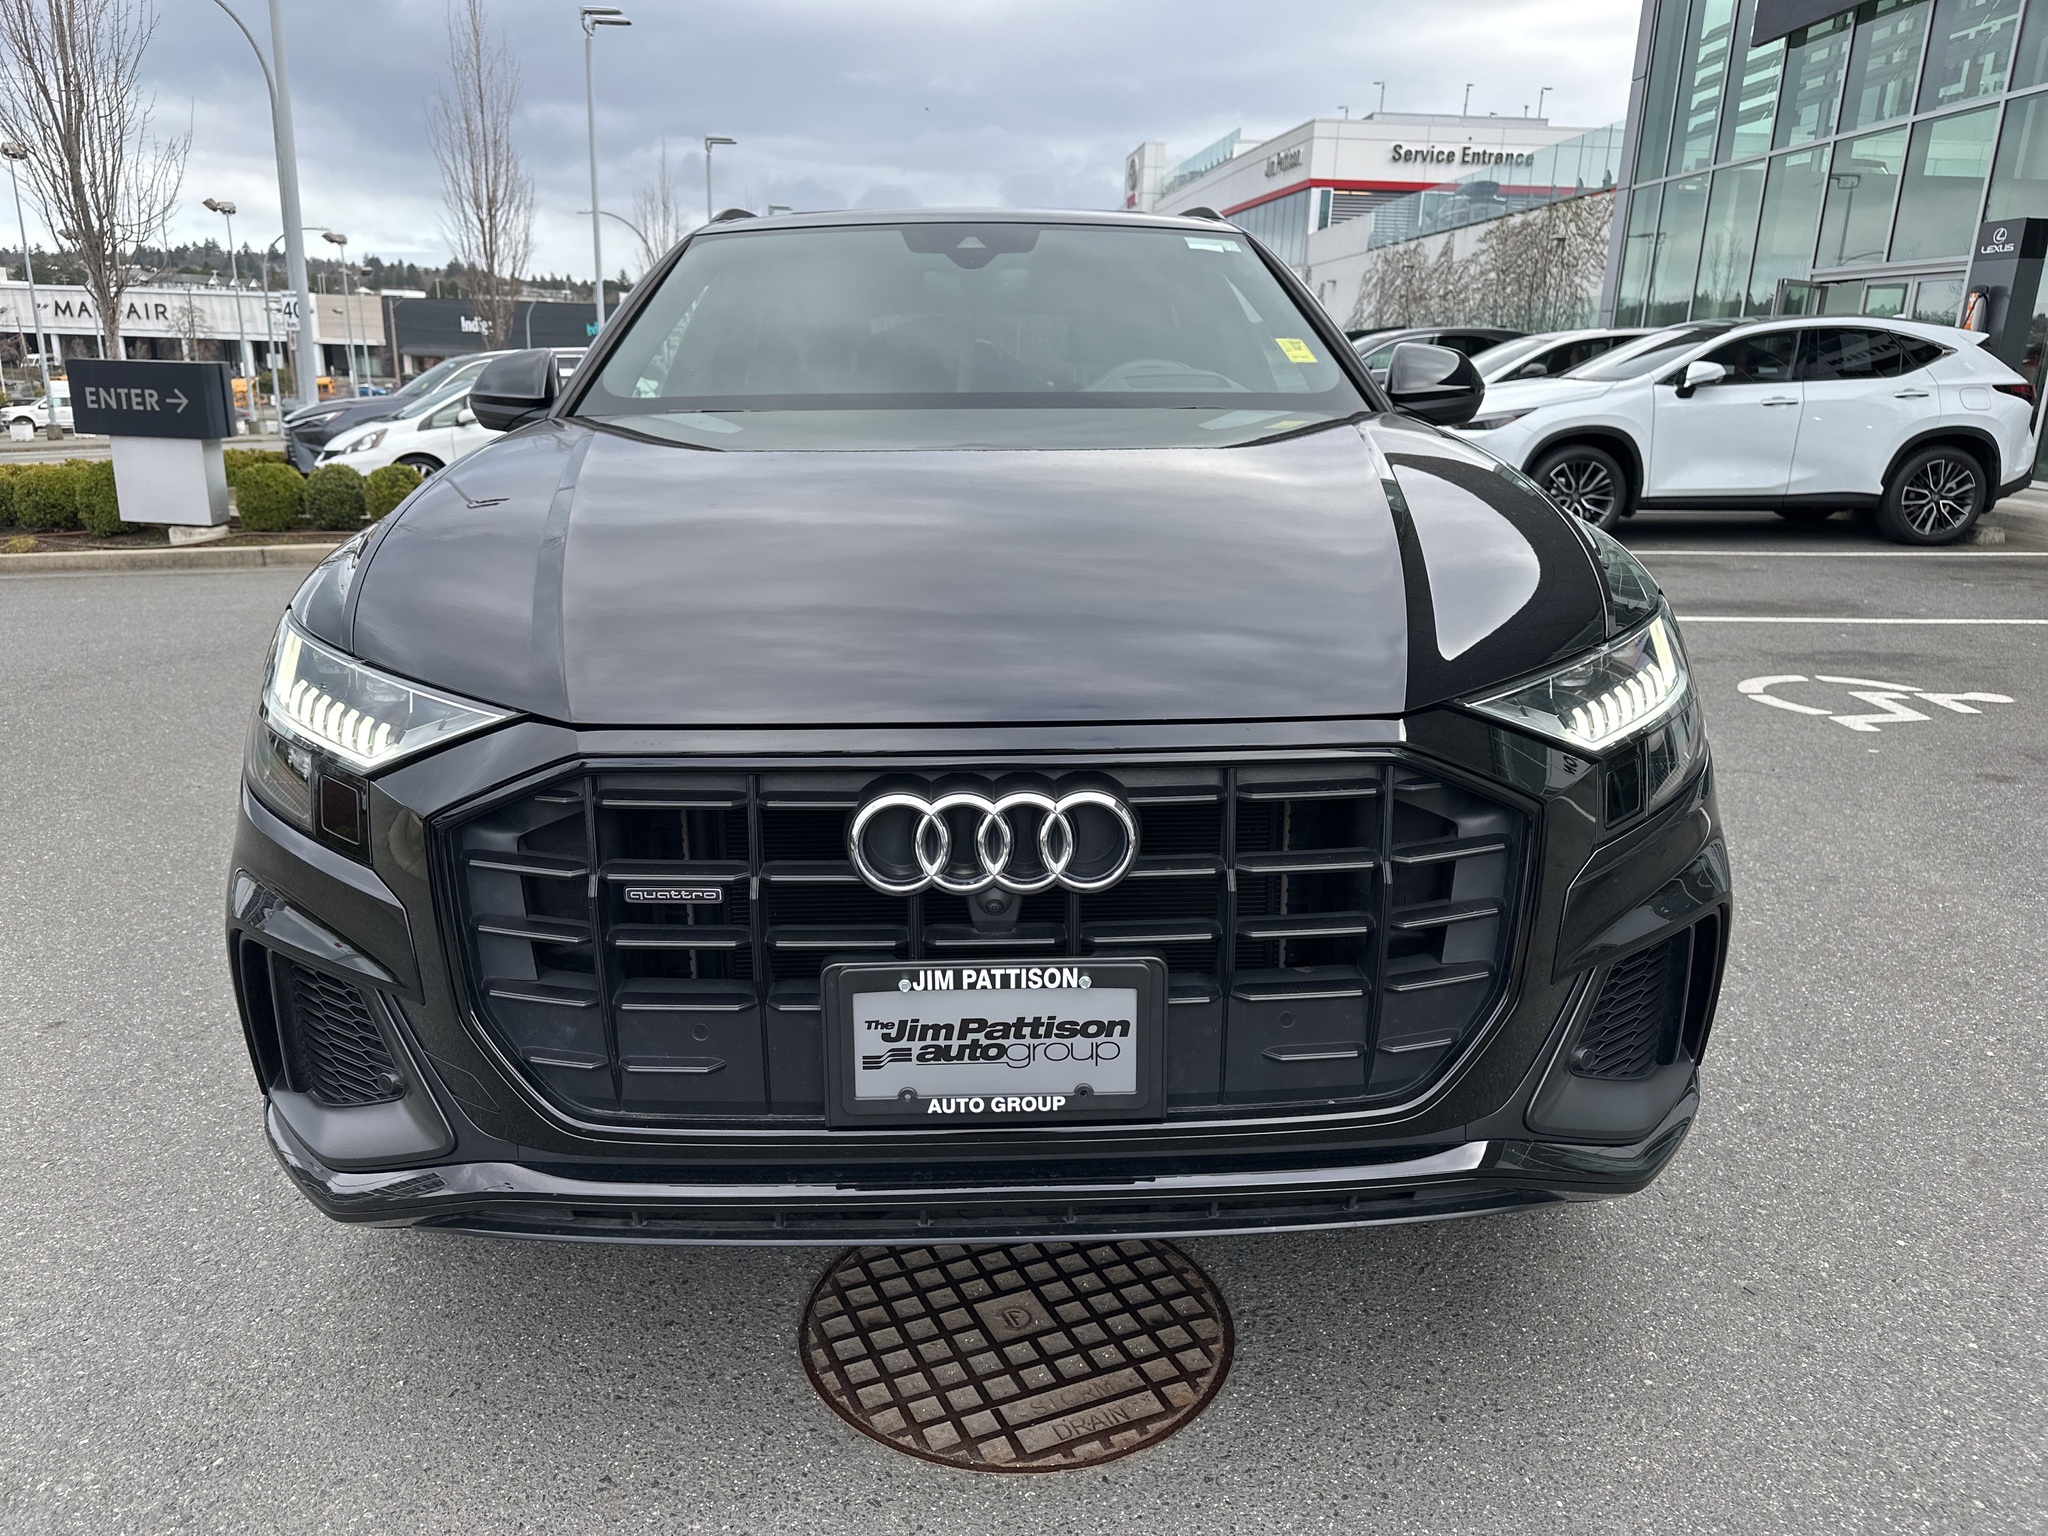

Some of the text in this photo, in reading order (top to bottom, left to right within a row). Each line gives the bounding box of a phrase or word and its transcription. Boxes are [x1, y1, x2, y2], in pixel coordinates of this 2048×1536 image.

[1392, 144, 1534, 167] Service Entrance
[1981, 243, 2014, 254] LEXUS
[54, 300, 169, 321] MAAIR
[84, 386, 161, 412] ENTER
[630, 890, 716, 900] quattro
[912, 968, 1079, 991] JIM PATTISON
[865, 1015, 1130, 1043] The Jim Pattison
[927, 1096, 1066, 1114] AUTO GROUP
[1051, 1404, 1131, 1441] DRAIN
